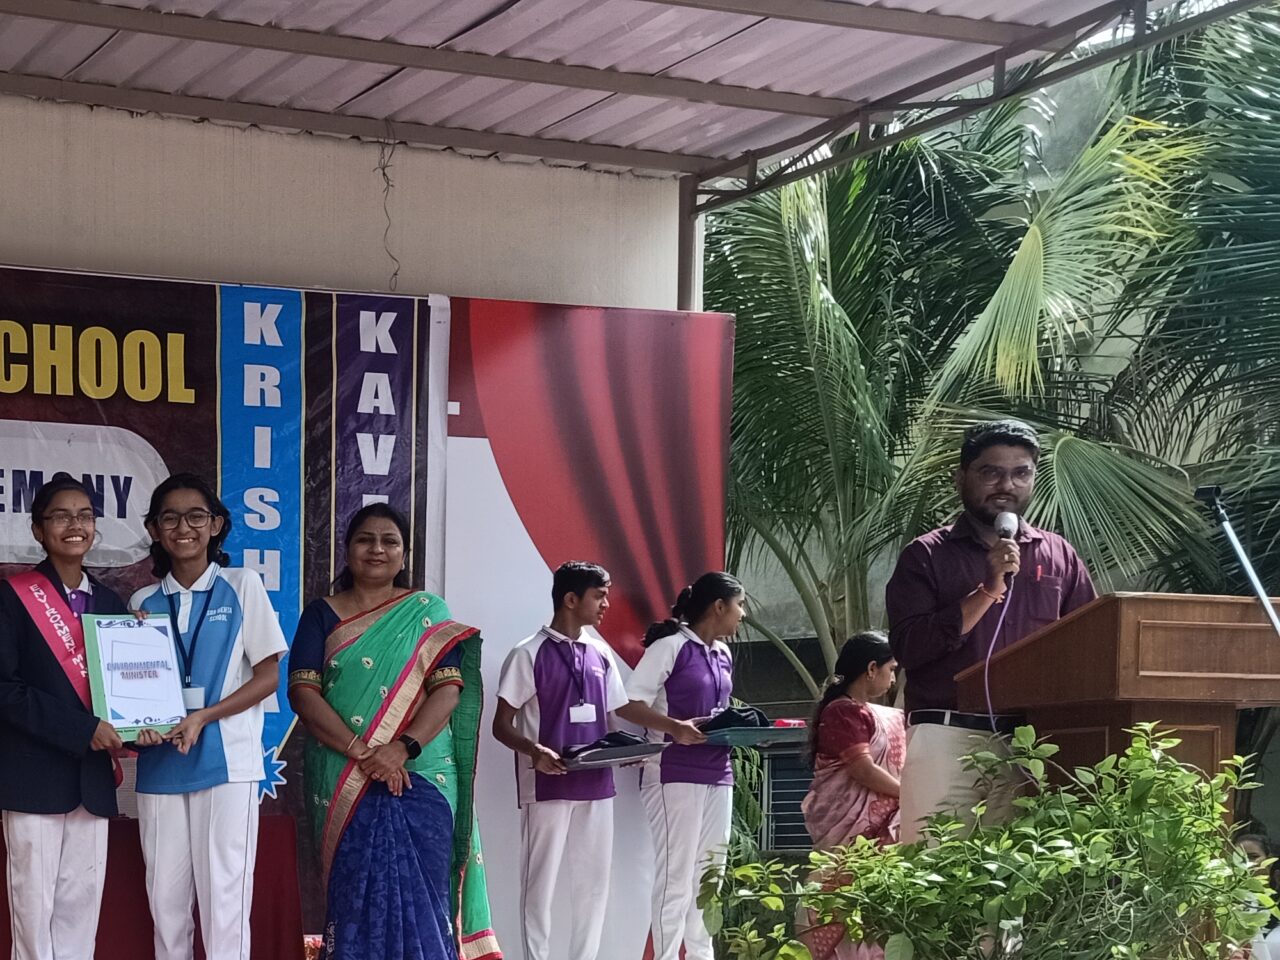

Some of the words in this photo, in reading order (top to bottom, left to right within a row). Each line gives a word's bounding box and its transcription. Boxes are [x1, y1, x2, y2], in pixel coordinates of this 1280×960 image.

[356, 309, 398, 510] KAV
[242, 302, 284, 713] KRISH
[28, 583, 76, 655] ENVIRONMENT
[119, 670, 160, 680] MINISTER
